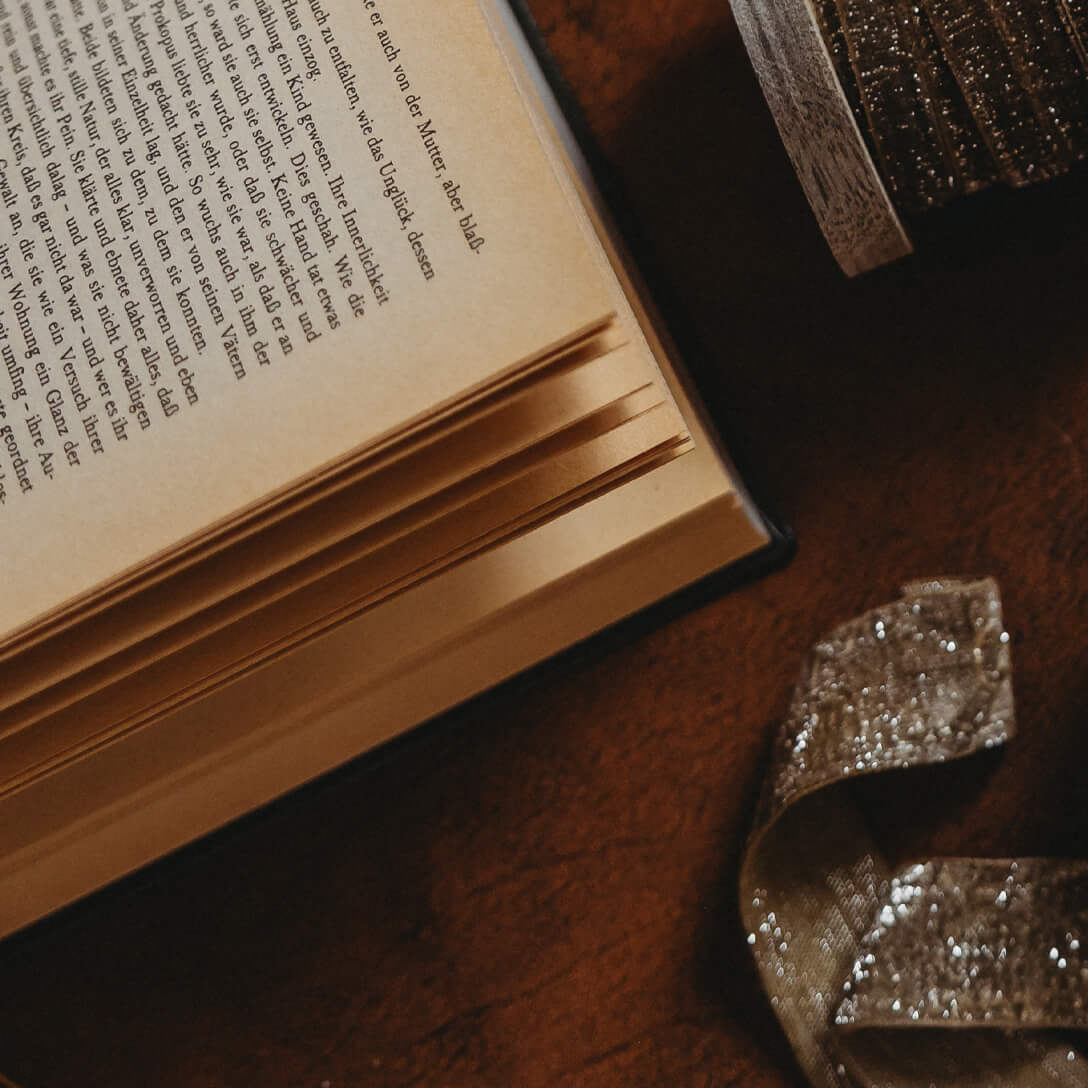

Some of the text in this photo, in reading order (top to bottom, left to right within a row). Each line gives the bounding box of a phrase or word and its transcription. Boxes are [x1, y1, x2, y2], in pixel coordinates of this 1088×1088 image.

[185, 21, 322, 343] herrlicher wurde, oder daß sie schwächer und
[204, 4, 340, 330] so ward sie auch sie selbst. Keine Hand tat etwas
[234, 14, 365, 318] sich erst entwickeln. Dies geschah. Wie die
[277, 54, 389, 306] ein Kind gewesen. Ihre Innerlichkeit
[297, 35, 321, 81] einzog.
[321, 27, 334, 44] zu
[329, 46, 359, 110] entfalten,
[356, 110, 373, 135] wie
[367, 138, 384, 162] das
[380, 161, 414, 230] Unglück,
[408, 232, 434, 280] dessen
[370, 13, 383, 26] er
[377, 30, 400, 62] auch
[393, 65, 409, 91] von
[405, 95, 422, 117] der
[417, 119, 446, 178] Mutter,
[443, 180, 464, 212] aber
[459, 213, 484, 254] blaß-
[8, 123, 128, 441] Kreis, daß es gar nicht da war und wer es ihr
[9, 212, 104, 454] an, die sie wie ein Versuch ihrer
[18, 77, 150, 430] übersichtlich dalag und was sie nicht bewältigen
[44, 78, 179, 417] es ihr Pein. Sie klärte und ebnete daher alles, daß
[68, 70, 198, 406] stille Natur, der alles klar, unverworren und eben
[92, 60, 206, 355] bildeten sich zu dem, zu dem sie konnten.
[121, 68, 246, 380] Einzelheit lag, und den er von seinen Vätern
[147, 80, 270, 365] gedacht hätte. So wuchs auch in ihm der
[172, 59, 293, 355] liebte sie zu sehr, wie sie war, als daß er an
[0, 425, 32, 494] geordnet
[1, 344, 53, 480] umfing ihre Au-
[8, 282, 80, 466] Wohnung ein Glanz der
